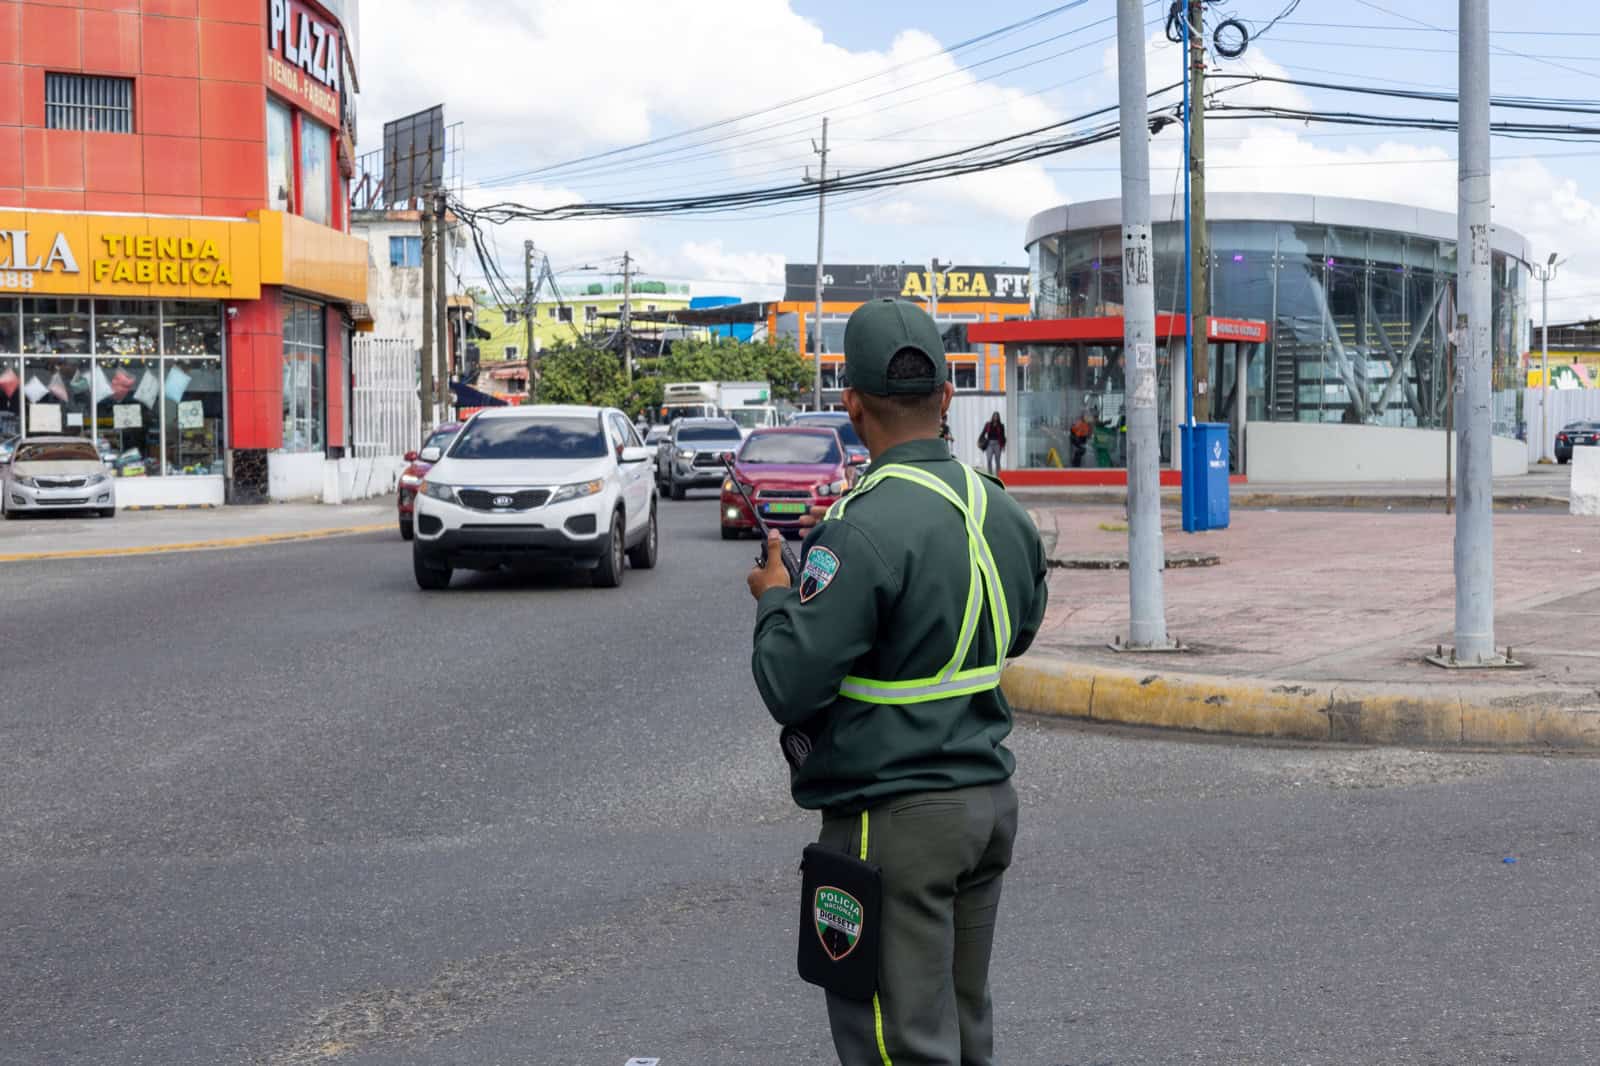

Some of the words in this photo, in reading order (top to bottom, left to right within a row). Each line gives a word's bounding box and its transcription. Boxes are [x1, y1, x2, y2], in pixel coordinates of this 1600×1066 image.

[270, 0, 340, 92] PLAZA
[268, 55, 298, 94] TIENDA
[303, 79, 337, 117] FABRICA
[101, 234, 220, 261] TIENDA
[93, 259, 233, 286] FABRICA
[901, 272, 991, 297] AREA
[820, 892, 860, 916] POLICIA
[824, 902, 854, 919] NACIONAL
[820, 910, 857, 931] DIGESETT
